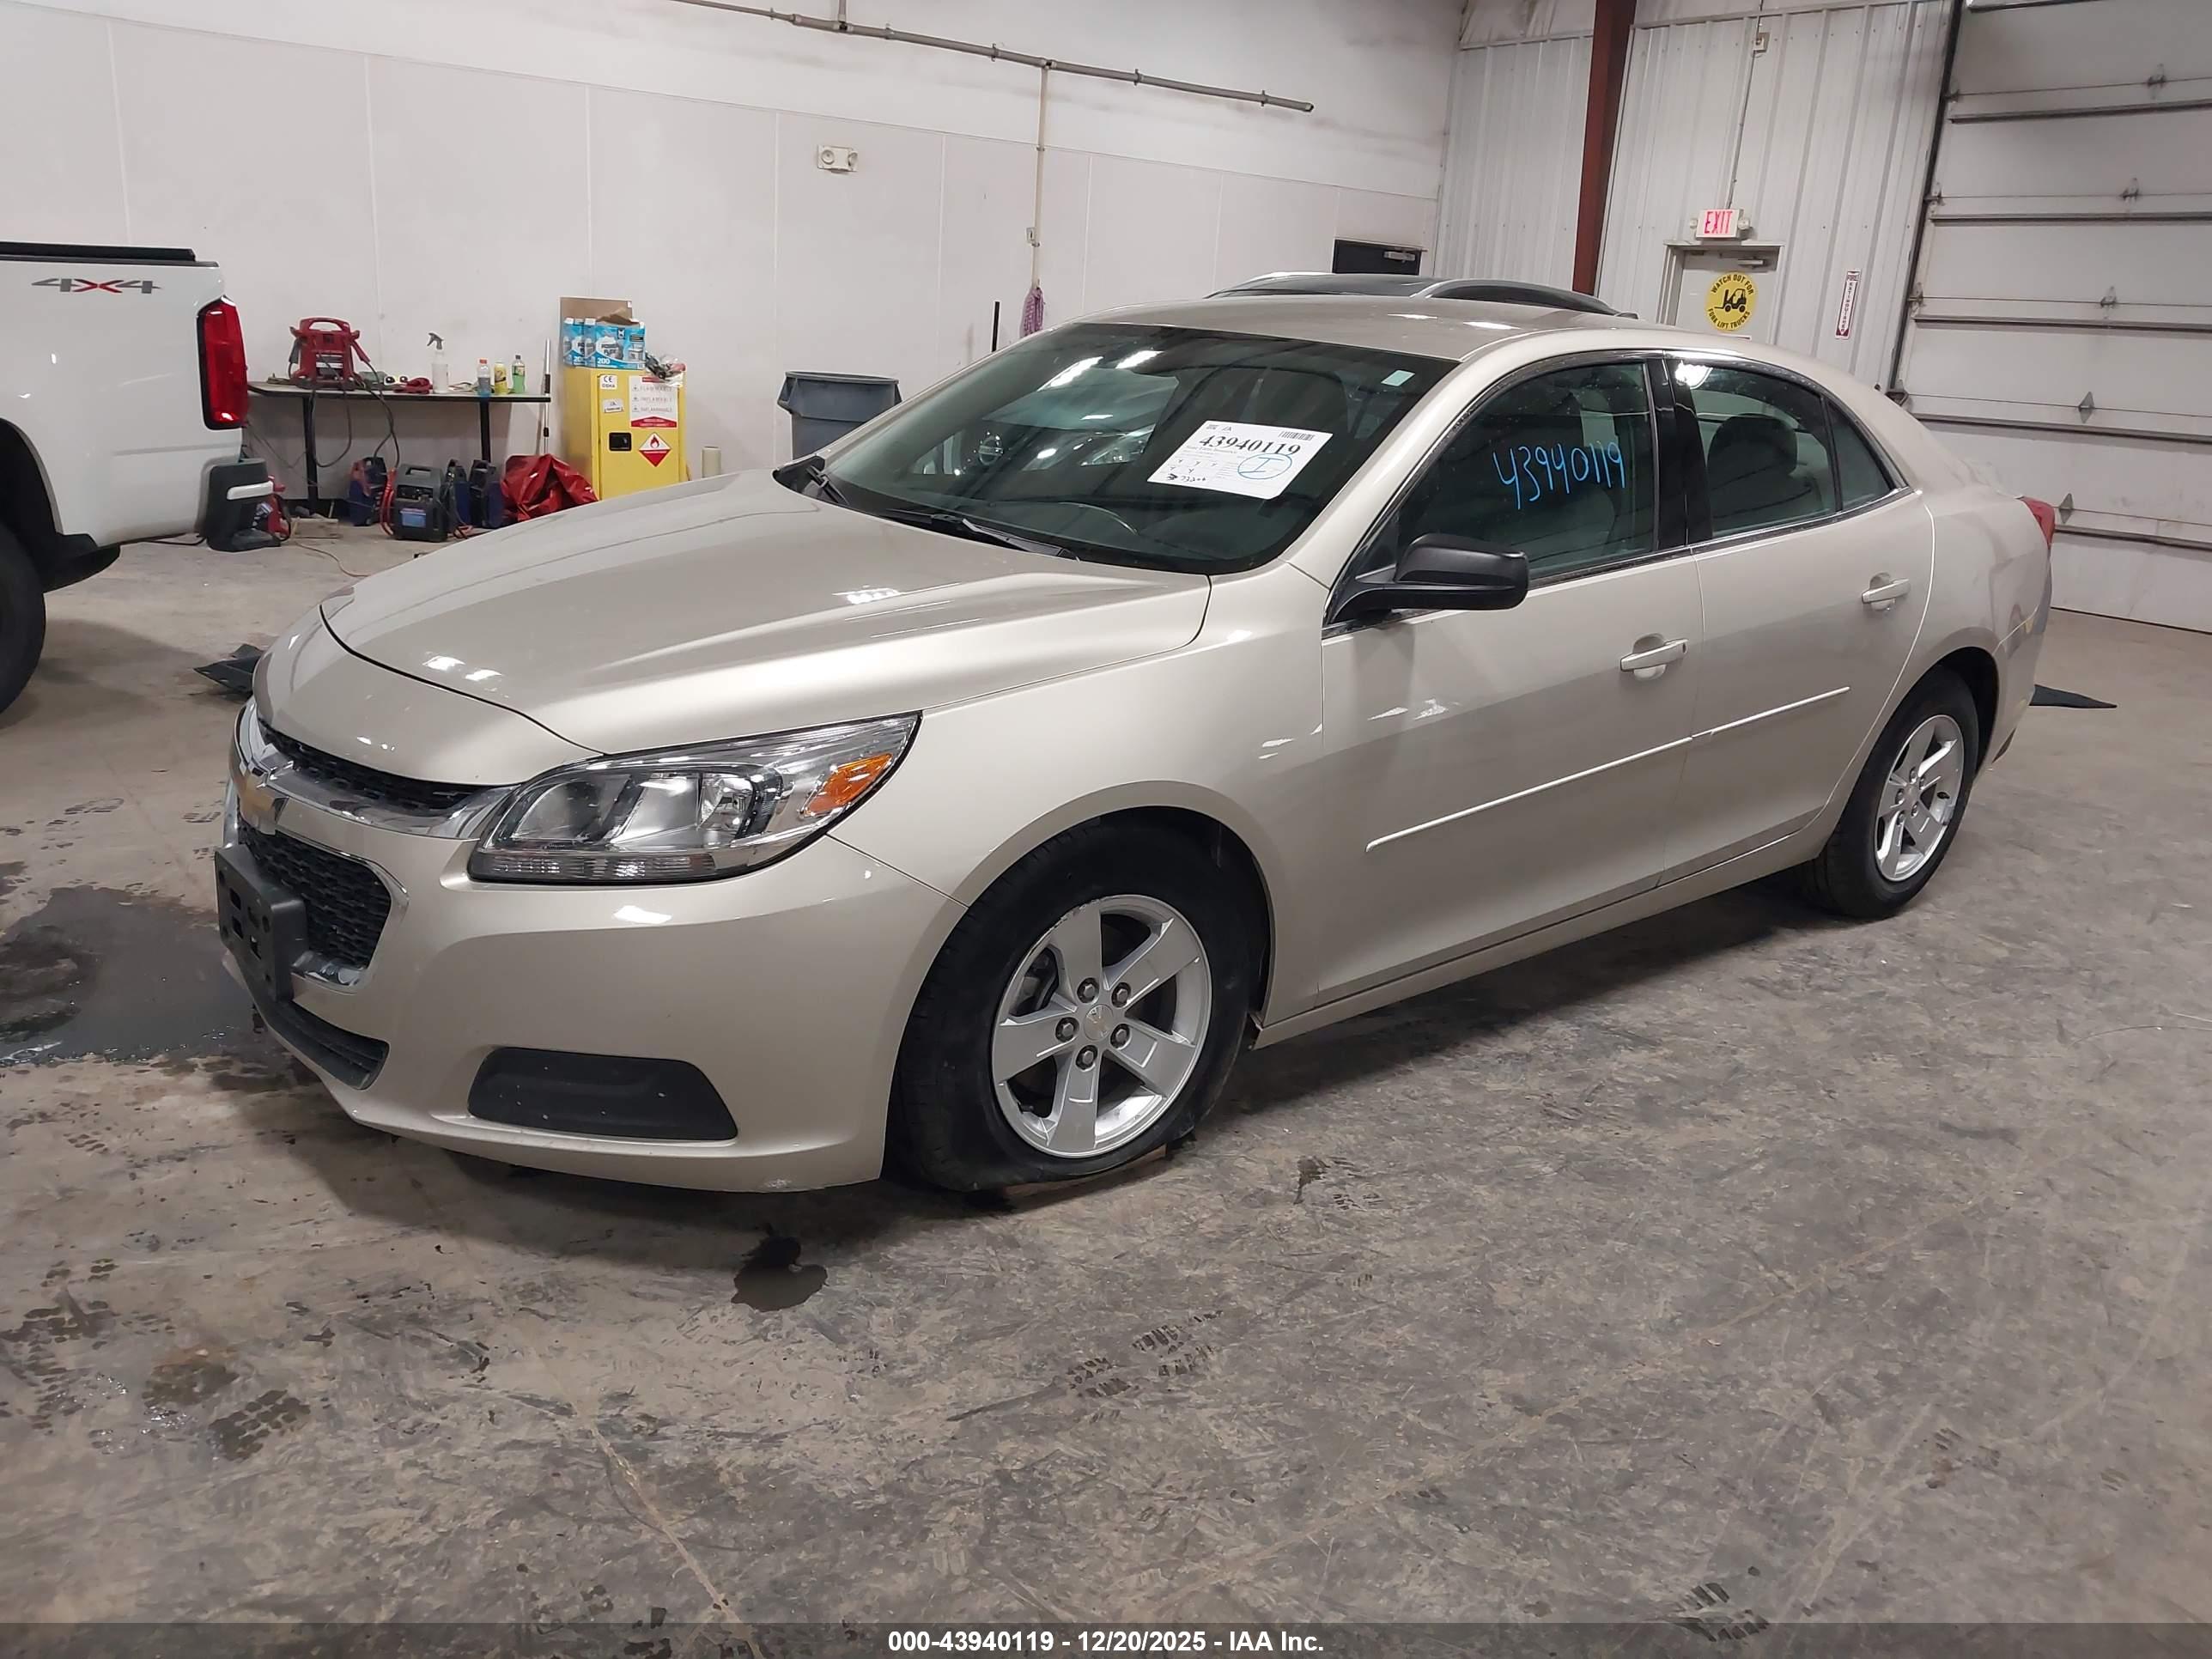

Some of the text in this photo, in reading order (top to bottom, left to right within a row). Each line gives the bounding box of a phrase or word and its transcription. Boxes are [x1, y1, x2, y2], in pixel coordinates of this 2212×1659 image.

[1704, 210, 1734, 234] EXIT
[1711, 274, 1754, 295] WATCH OUT FOR
[1717, 320, 1729, 329] LIFT
[1729, 311, 1751, 329] TRUCKS
[1199, 434, 1301, 456] 43940119
[1492, 441, 1626, 510] 43940119
